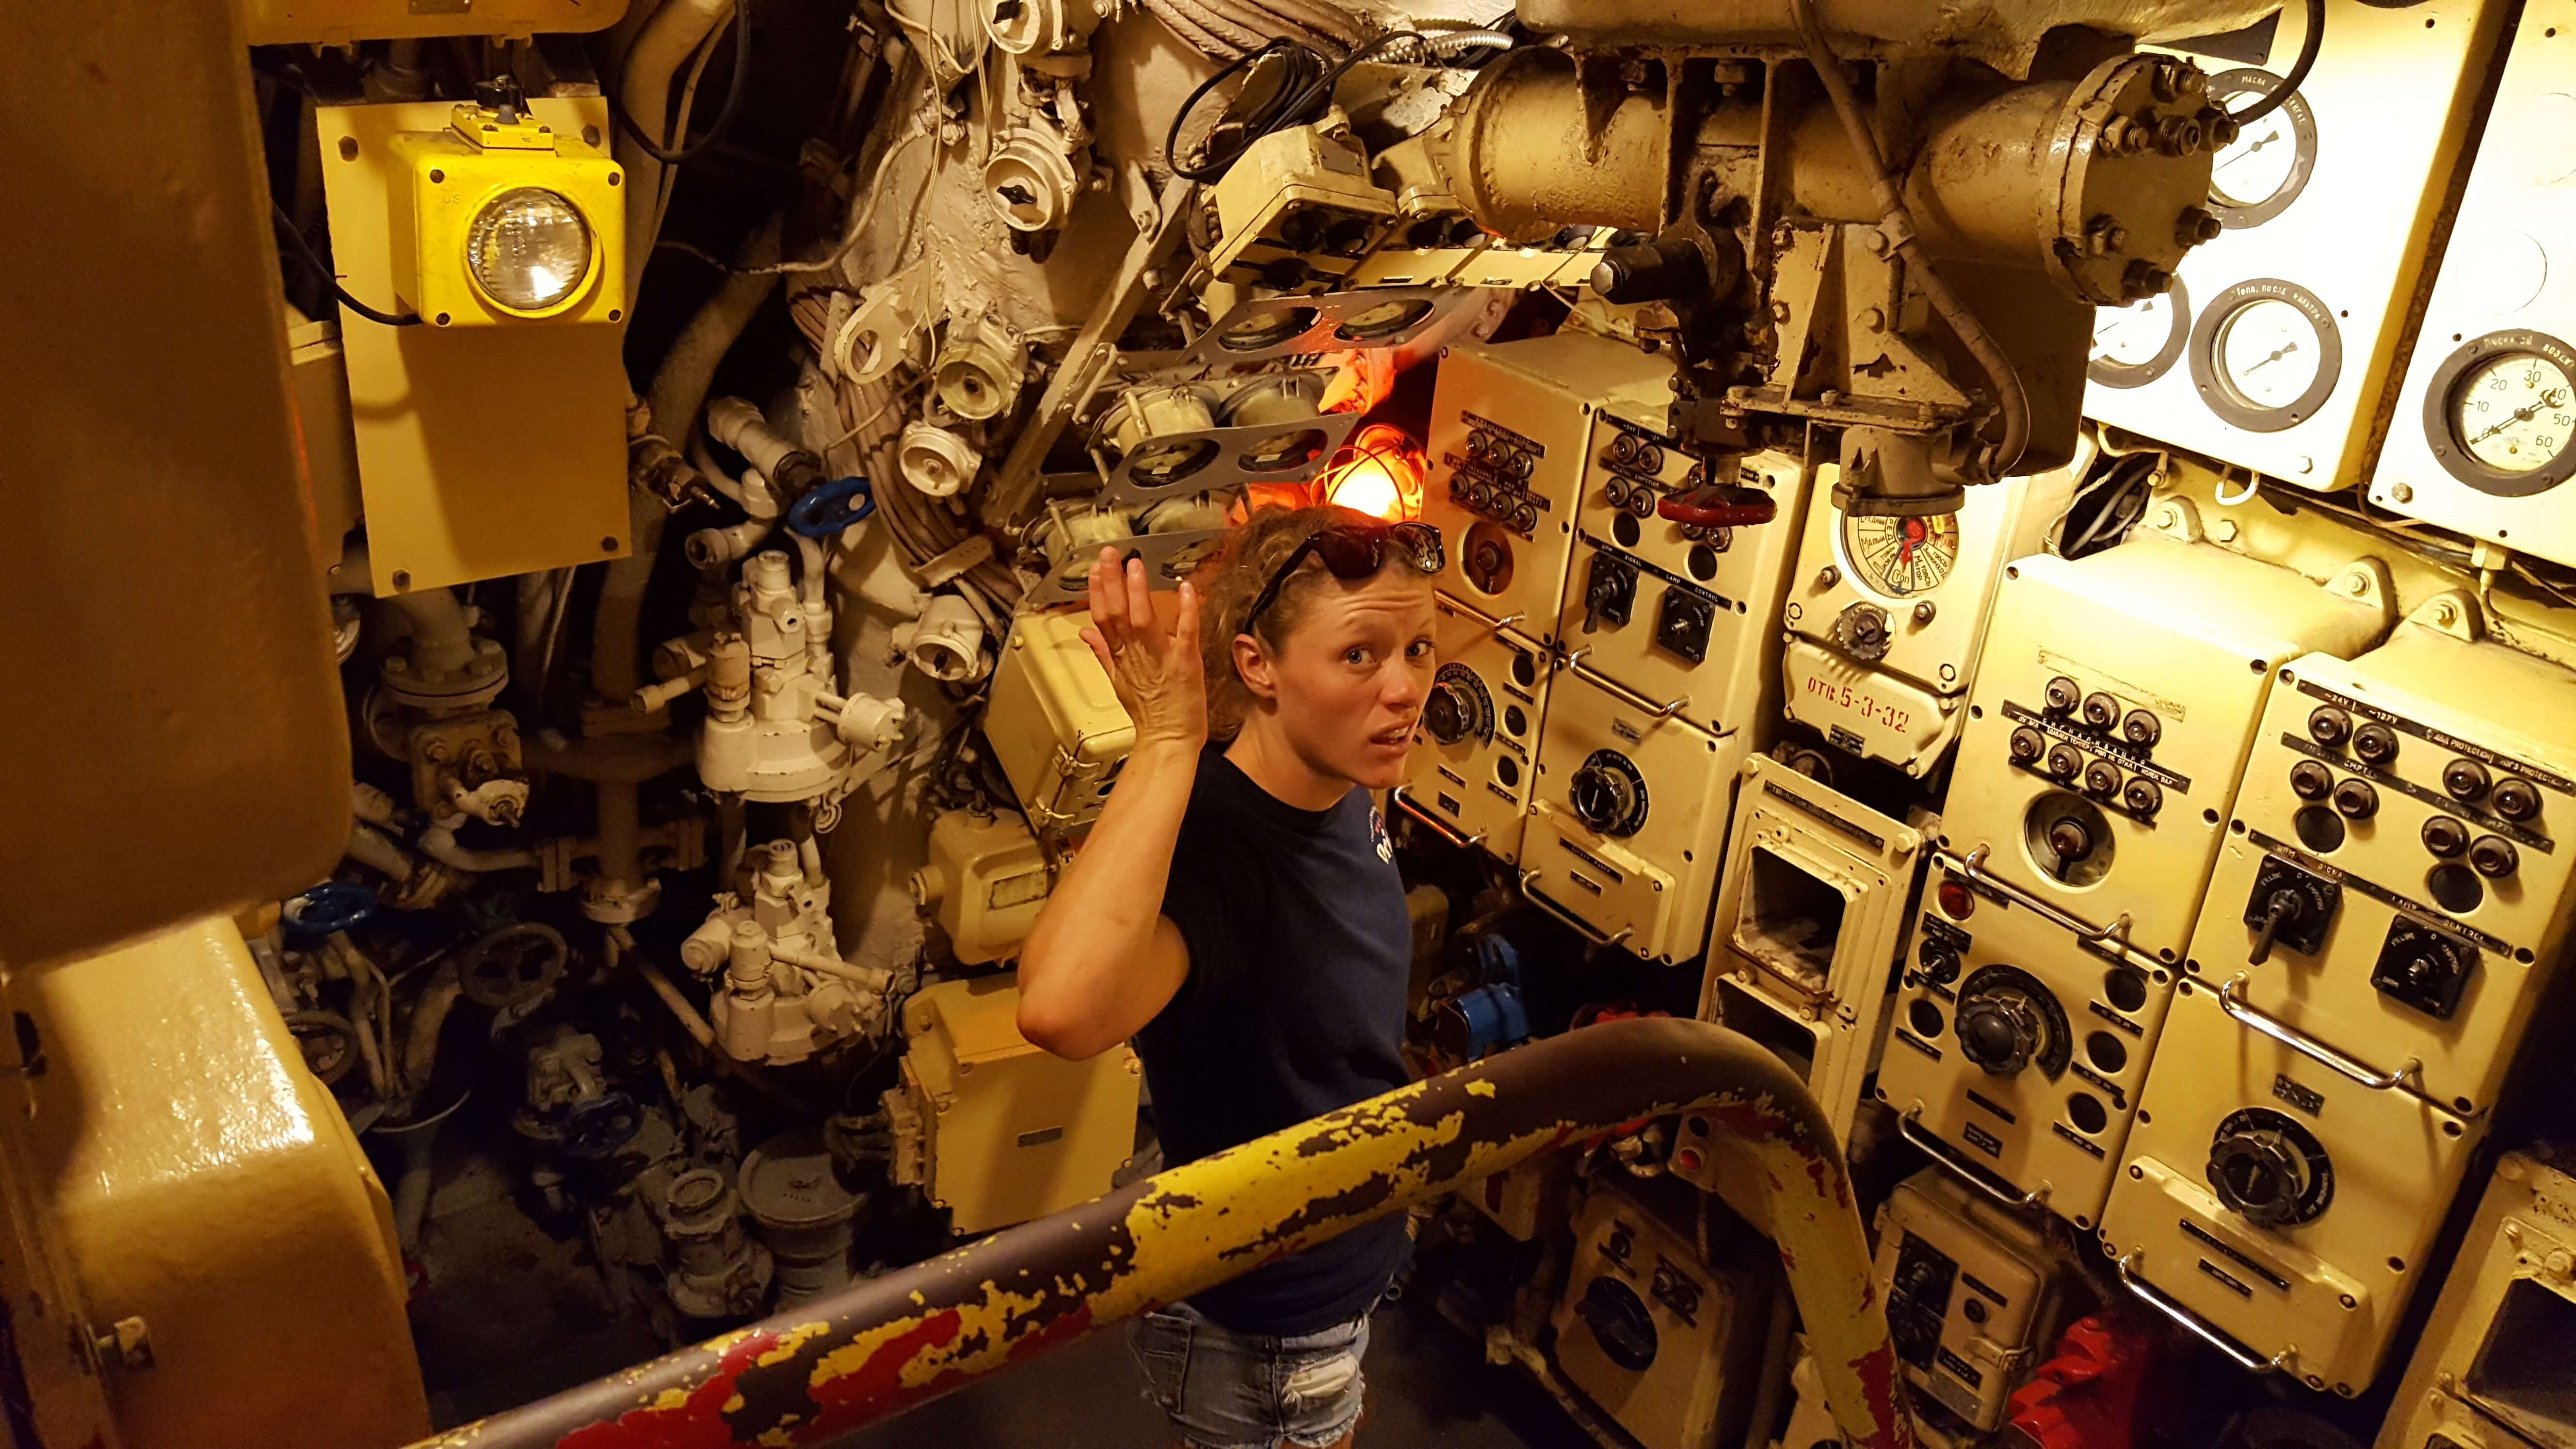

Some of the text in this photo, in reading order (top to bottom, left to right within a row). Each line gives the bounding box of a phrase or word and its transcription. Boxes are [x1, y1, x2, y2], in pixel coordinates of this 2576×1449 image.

[2524, 370, 2542, 383] 30
[2490, 378, 2508, 391] 20
[2477, 400, 2489, 412] 10
[2553, 413, 2570, 427] 50
[2535, 435, 2553, 448] 60
[1625, 555, 1642, 567] SIGNAL
[1666, 574, 1680, 584] LAMP
[1695, 587, 1719, 603] CONTROL
[2318, 864, 2346, 880] SIGNA
